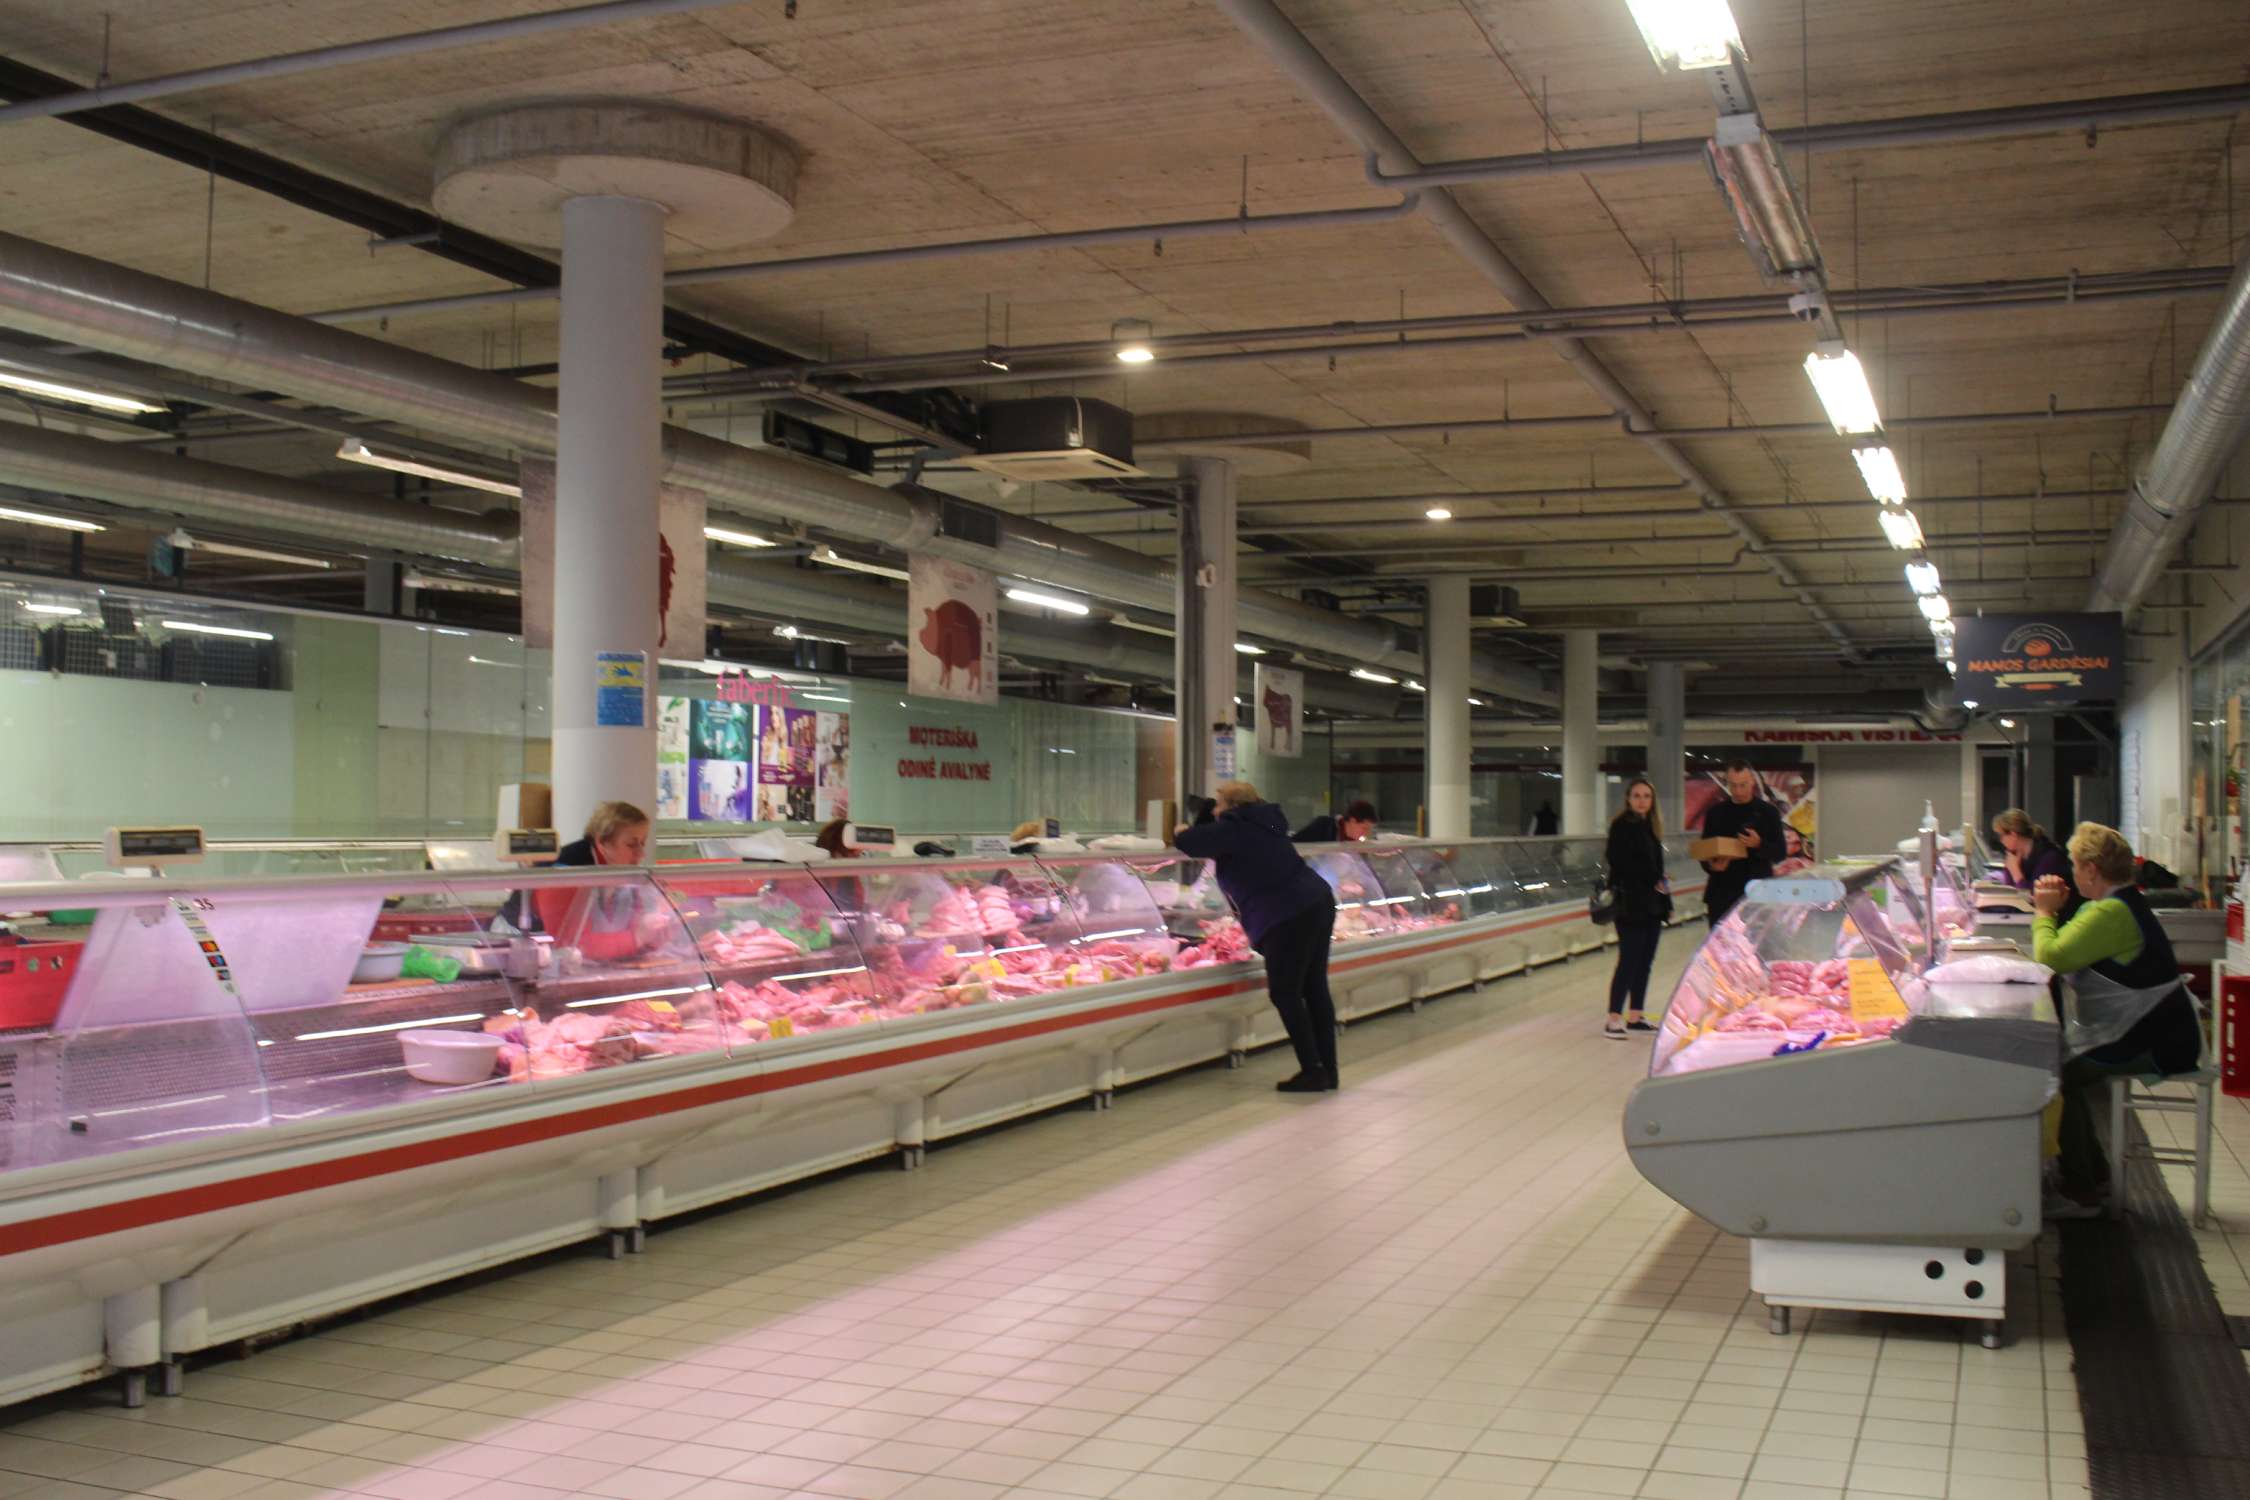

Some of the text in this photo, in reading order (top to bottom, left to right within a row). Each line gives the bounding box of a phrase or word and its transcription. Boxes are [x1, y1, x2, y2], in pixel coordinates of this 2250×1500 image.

[1967, 659, 2025, 673] MAMOS
[897, 756, 992, 781] ODINĖ AVALYNĖ
